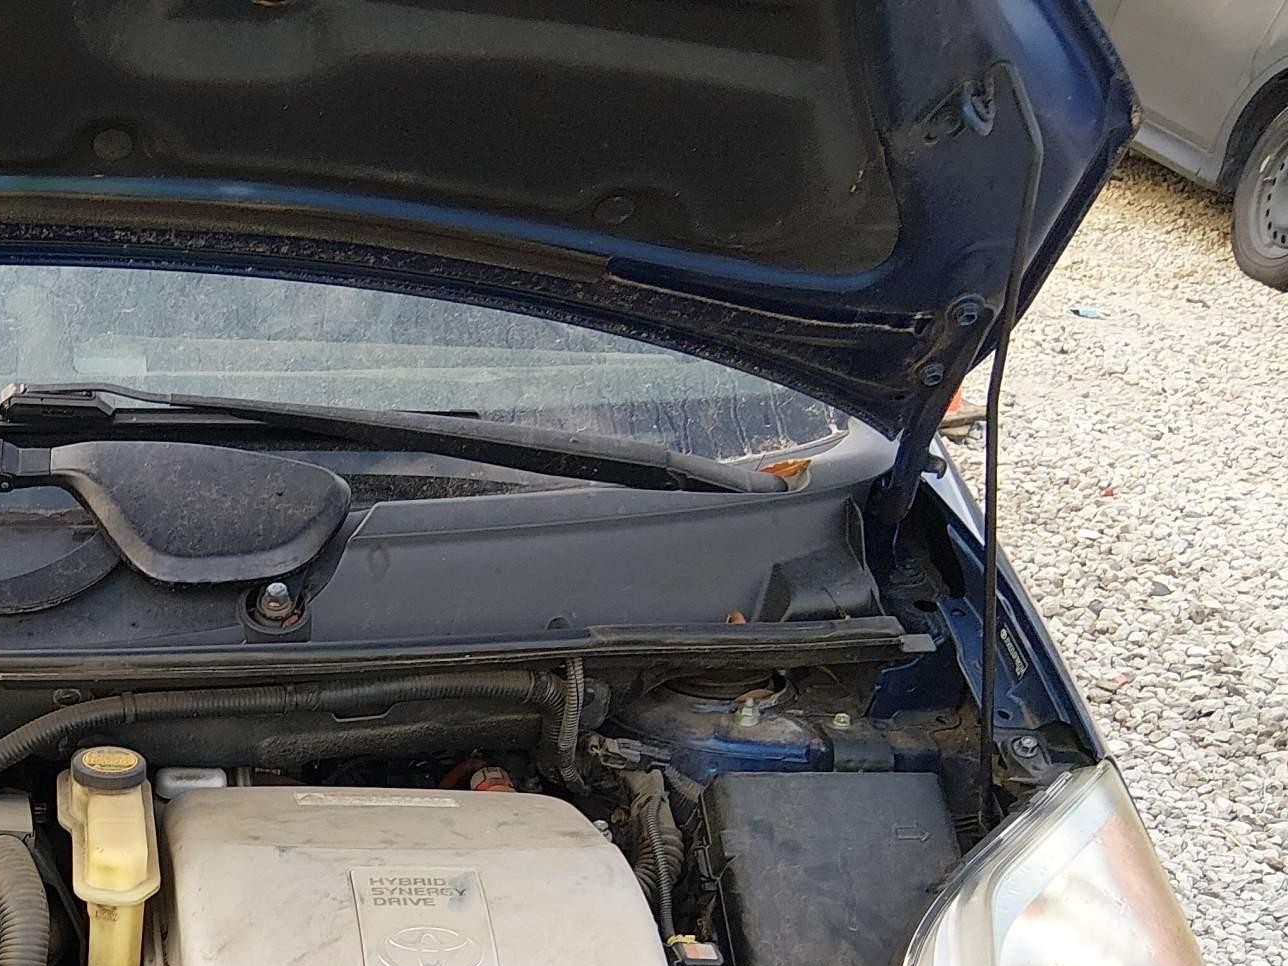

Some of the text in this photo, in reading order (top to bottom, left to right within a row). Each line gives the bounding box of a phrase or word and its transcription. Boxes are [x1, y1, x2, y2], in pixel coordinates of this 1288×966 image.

[369, 877, 447, 886] HYBRID
[371, 887, 466, 896] SYNERGY
[374, 897, 436, 906] DRIVE
